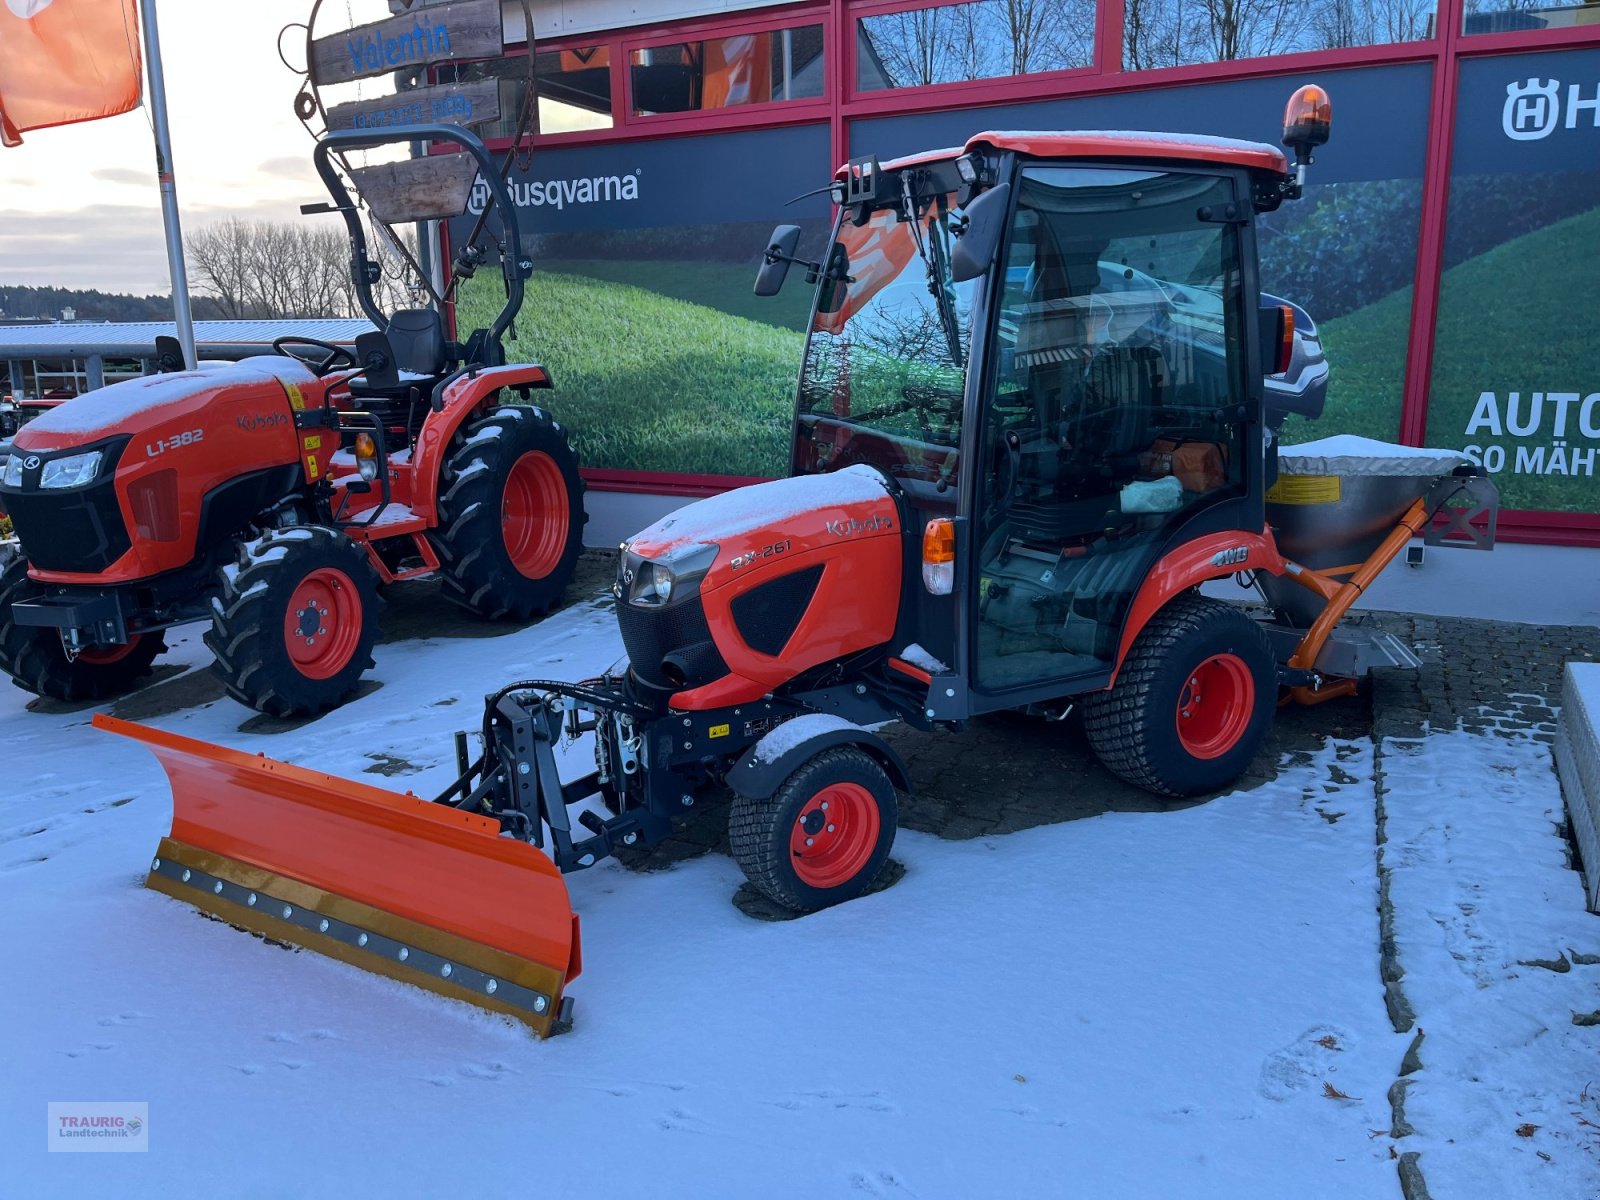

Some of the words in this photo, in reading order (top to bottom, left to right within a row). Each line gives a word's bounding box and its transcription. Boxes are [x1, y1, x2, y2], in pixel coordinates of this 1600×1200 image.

[346, 20, 450, 74] Valentin
[237, 411, 289, 430] Kubota
[146, 428, 204, 457] L1-382
[1462, 444, 1506, 473] SO
[1514, 440, 1600, 476] MÄH
[825, 511, 893, 536] Kubota
[1209, 545, 1249, 567] 4WD
